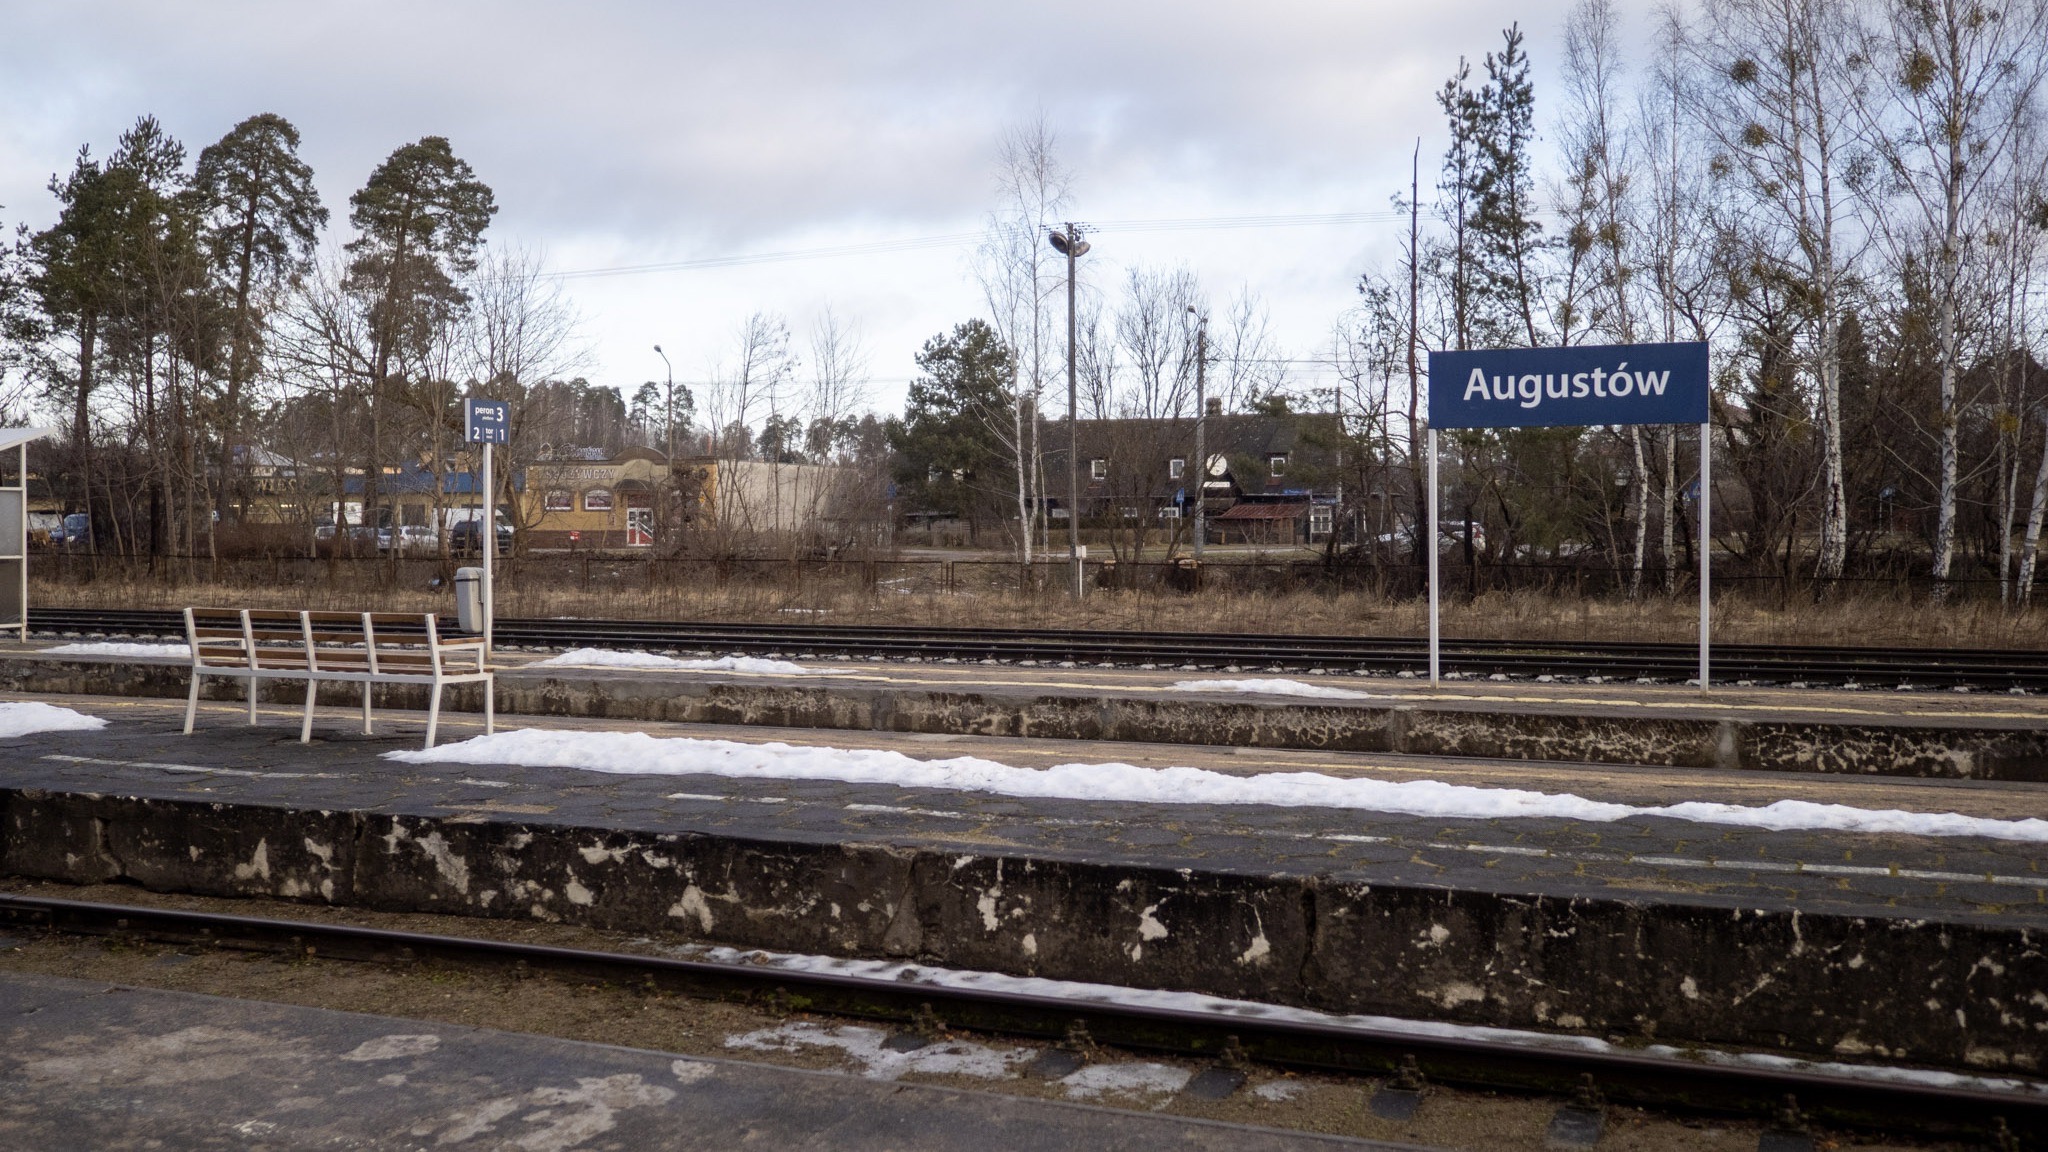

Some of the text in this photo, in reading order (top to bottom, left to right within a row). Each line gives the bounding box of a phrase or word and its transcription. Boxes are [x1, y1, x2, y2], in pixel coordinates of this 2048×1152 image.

[1463, 362, 1671, 409] Augustów
[475, 406, 504, 422] peron 3
[473, 426, 480, 439] 2
[499, 428, 505, 441] 1
